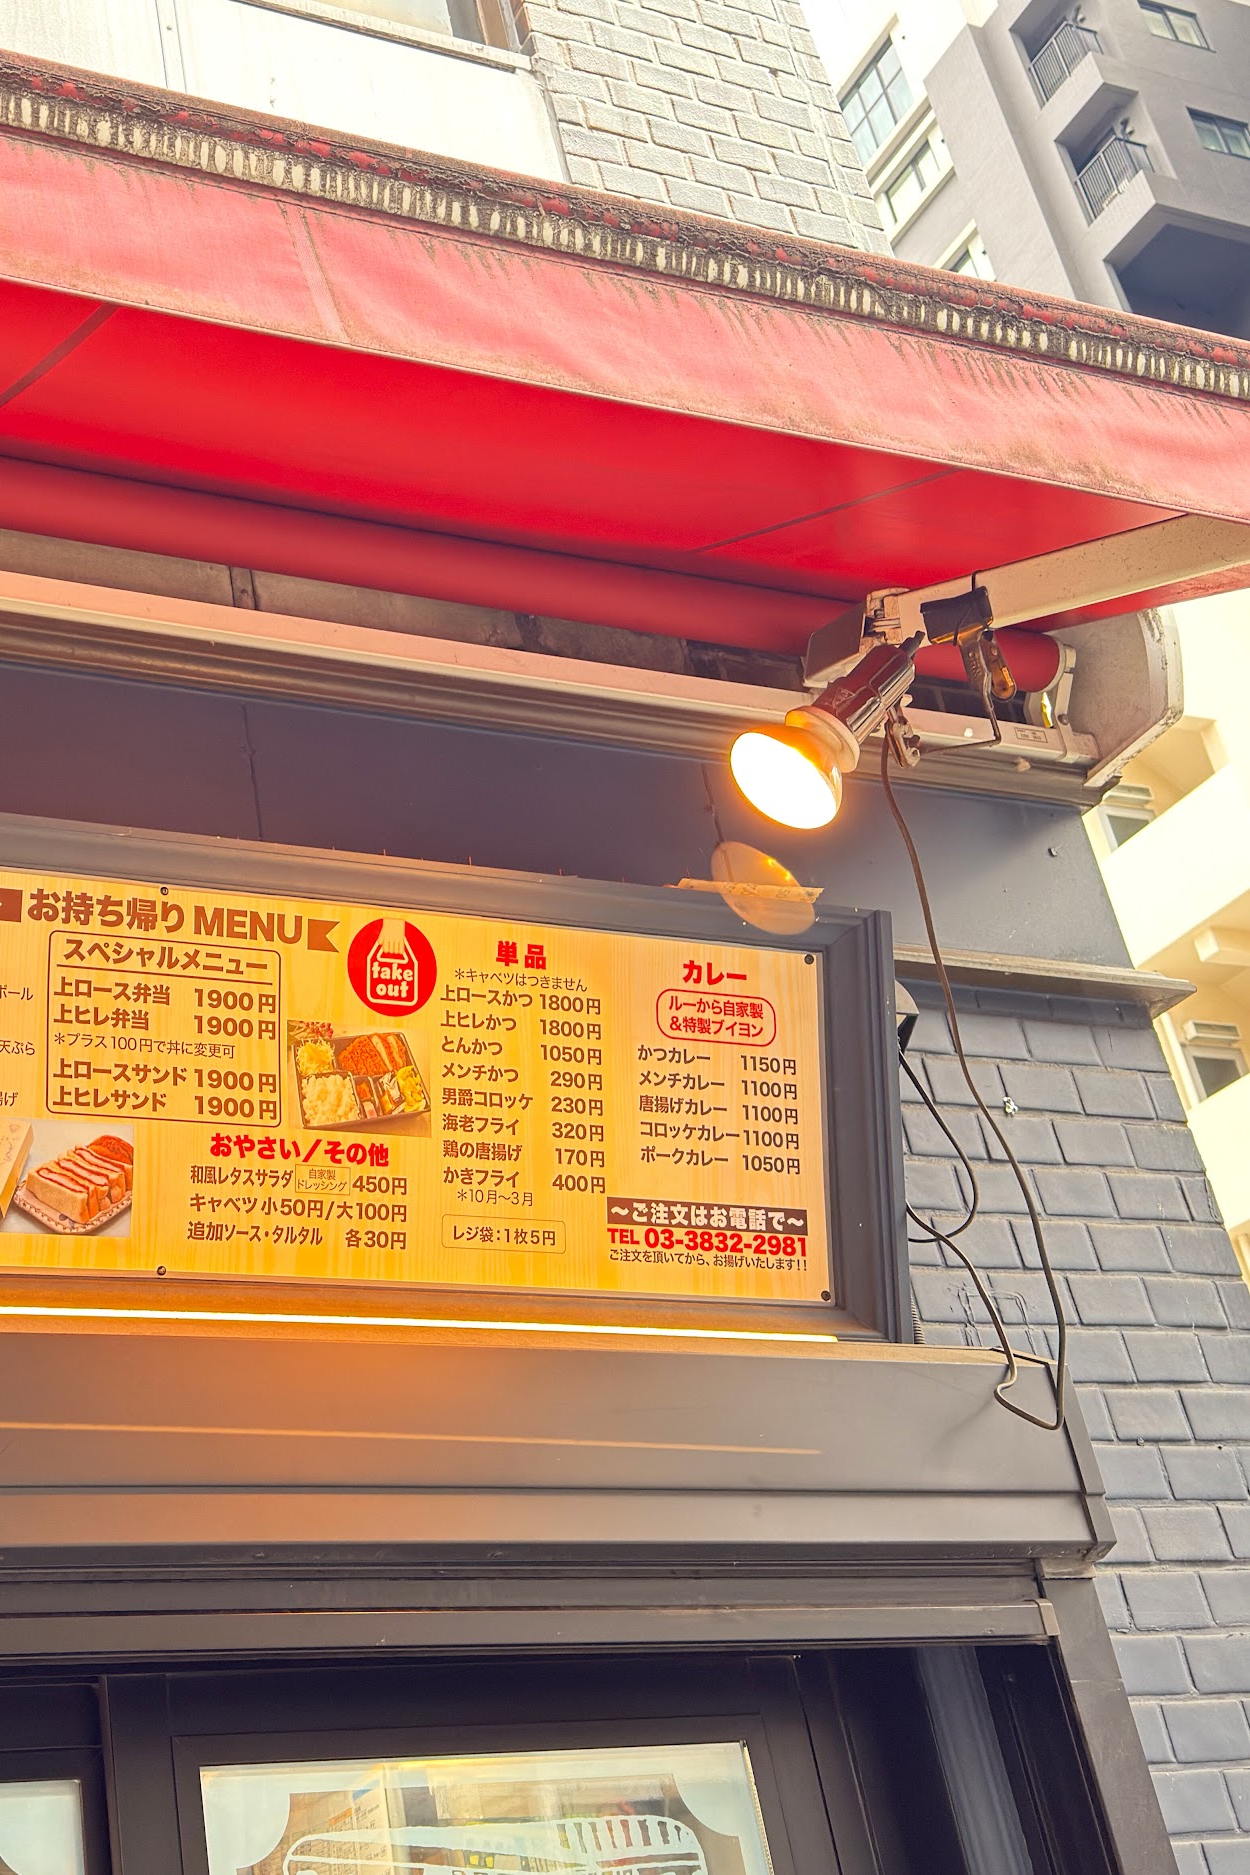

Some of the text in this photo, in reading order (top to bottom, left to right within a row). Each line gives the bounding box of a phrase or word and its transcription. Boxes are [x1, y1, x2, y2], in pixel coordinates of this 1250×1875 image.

[27, 888, 303, 945] お持ち帰り MENU
[63, 938, 268, 975] スペシャルメニュー
[495, 940, 547, 970] 単品
[371, 963, 414, 981] take
[682, 960, 747, 986] カレー
[53, 976, 276, 1014] 上ロース弁当 1900円
[376, 982, 409, 998] out
[440, 985, 601, 1015] 上ロースかつ 1800円
[53, 1003, 276, 1041] 上ヒレ弁当 1900円
[668, 995, 764, 1020] ルーから自家製
[440, 1010, 602, 1040] 上ヒレかつ 1800円
[441, 1036, 602, 1065] とんかつ 1050円
[637, 1044, 797, 1076] かつカレー 1150円
[52, 1058, 277, 1093] 上ロースサンド 1900円
[441, 1063, 603, 1091] メンチかつ 290円
[639, 1070, 797, 1101] メンチカレー 1100円
[52, 1086, 277, 1120] 上ヒレサンド 1900円
[442, 1087, 603, 1117] 男爵コロッケ 230円
[639, 1094, 798, 1125] 唐揚げカレー 1100円
[442, 1113, 604, 1142] 海老フライ 320円
[640, 1121, 799, 1150] コロッケカレー 1100円
[442, 1139, 605, 1168] 鶏の唐揚げ 170円
[640, 1145, 800, 1175] ポークカレー 1050円
[190, 1165, 407, 1196] 和風レタスサラダ 450円
[297, 1179, 349, 1192] ドレッシング
[308, 1168, 336, 1181] 自家製
[443, 1166, 606, 1194] かきフライ 400円
[187, 1221, 407, 1250] 追加ソース・タルタル 各30円
[607, 1227, 807, 1257] TEL 03-3832-2981
